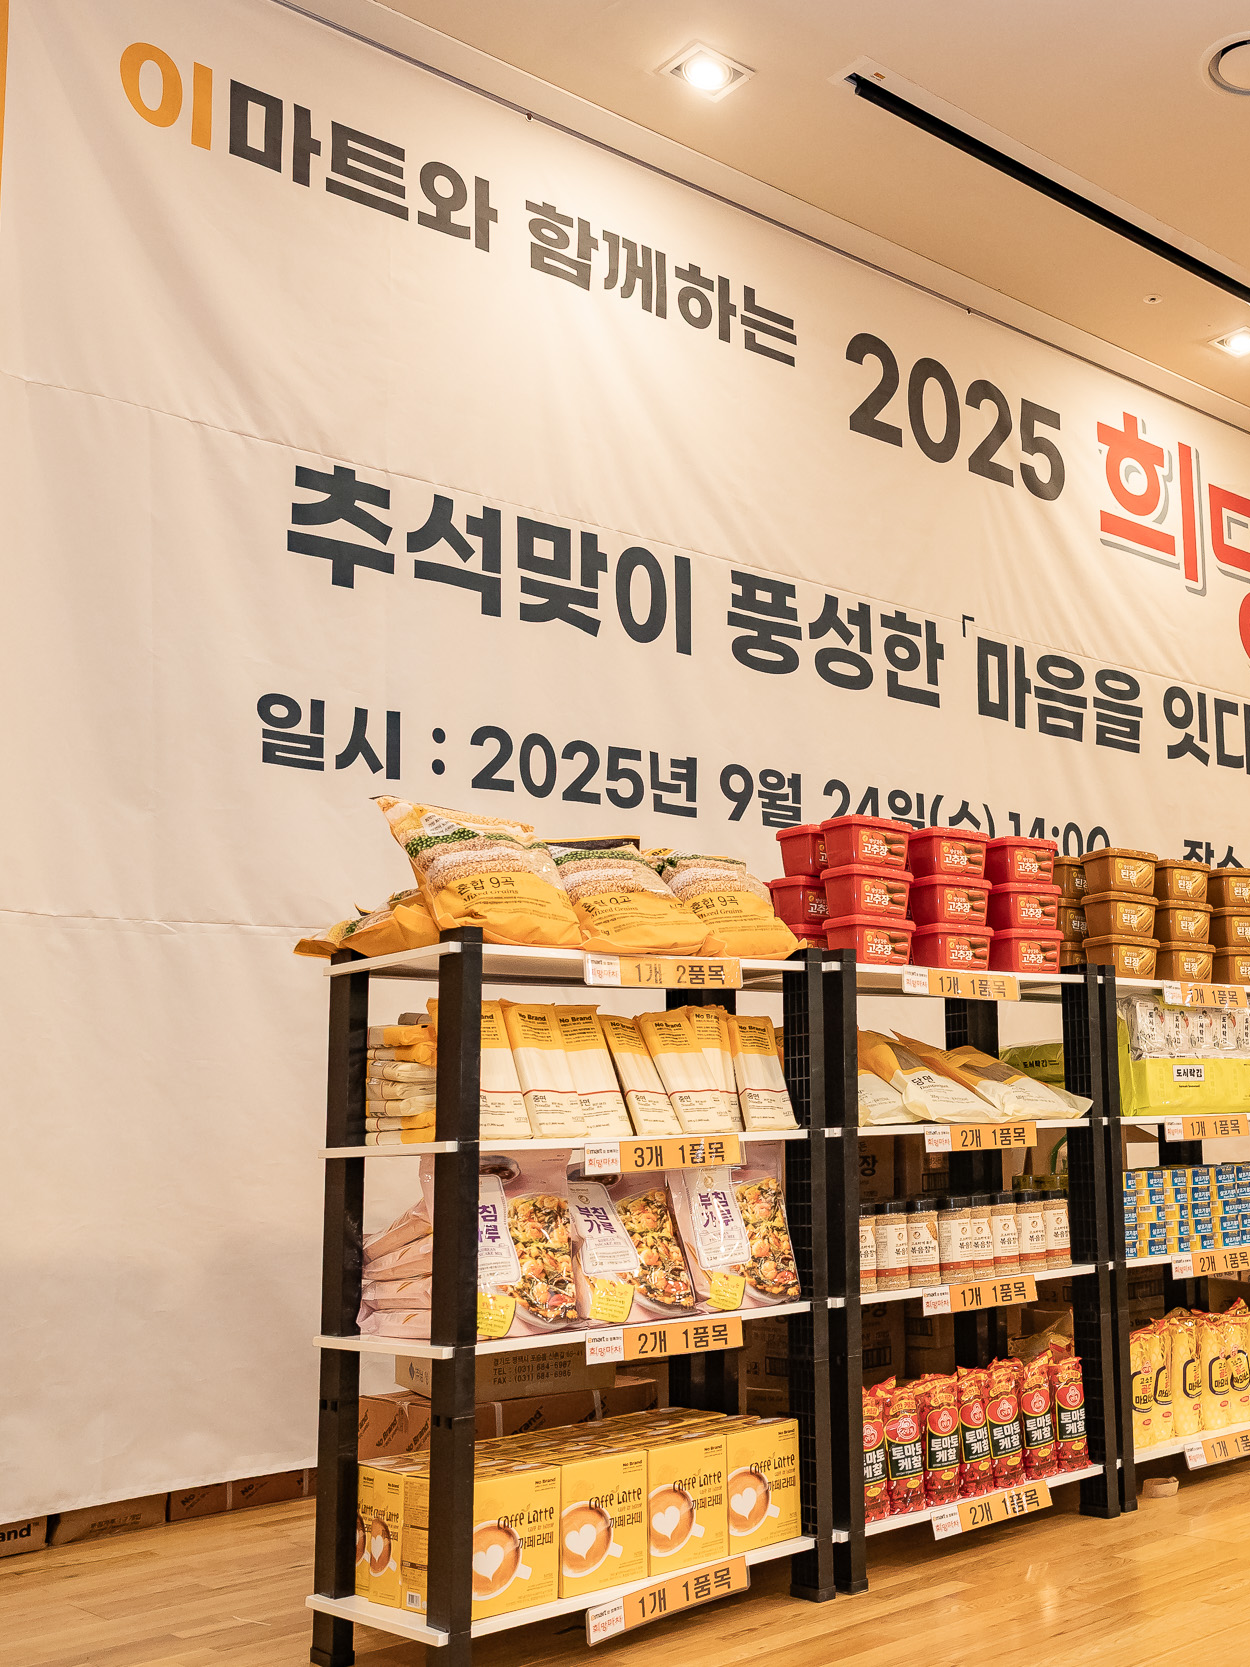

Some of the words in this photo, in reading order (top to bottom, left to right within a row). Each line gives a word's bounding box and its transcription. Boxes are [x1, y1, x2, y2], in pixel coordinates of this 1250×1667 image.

[120, 43, 498, 253] 이마트와
[526, 201, 799, 368] 함께하는
[845, 332, 1066, 501] 2025
[286, 464, 692, 656] 추석맞이
[727, 569, 945, 708] 풍성한
[256, 693, 401, 779] 일시
[431, 727, 446, 776] :
[470, 725, 698, 819] 2025년
[719, 763, 802, 829] 9월
[862, 842, 889, 856] 고추장
[944, 853, 968, 866] 고추장
[1017, 861, 1039, 873] 고추장
[1120, 869, 1137, 880] 된장
[1178, 880, 1193, 890] 된장
[1234, 887, 1250, 897] 된장
[1122, 913, 1138, 924] 된장
[867, 943, 893, 956] 고추장
[950, 949, 973, 961] 고추장
[635, 963, 663, 985] 1개
[676, 964, 726, 985] 2품목
[939, 975, 960, 995] 1개
[1212, 989, 1239, 1005] 1품목
[1175, 1068, 1203, 1078] 도시락김
[1190, 1121, 1206, 1137] 1개
[1214, 1119, 1240, 1136] 1품목
[960, 1128, 982, 1148] 2개
[992, 1127, 1026, 1146] 1품목
[634, 1145, 664, 1168] 3개
[678, 1141, 725, 1165] 1품목
[1199, 1256, 1217, 1273] 2개
[1223, 1251, 1250, 1270] 1품목
[960, 1287, 982, 1307] 1개
[992, 1281, 1027, 1303] 1품목
[588, 1336, 605, 1344] emart
[638, 1330, 667, 1355] 2개
[682, 1323, 729, 1349] 1품목
[1211, 1440, 1229, 1459] 1개
[699, 1470, 722, 1488] Latte
[617, 1487, 642, 1505] Latte
[527, 1506, 555, 1524] Latte
[969, 1501, 993, 1526] 2개
[638, 1587, 667, 1618] 1개
[682, 1567, 732, 1602] 1품목
